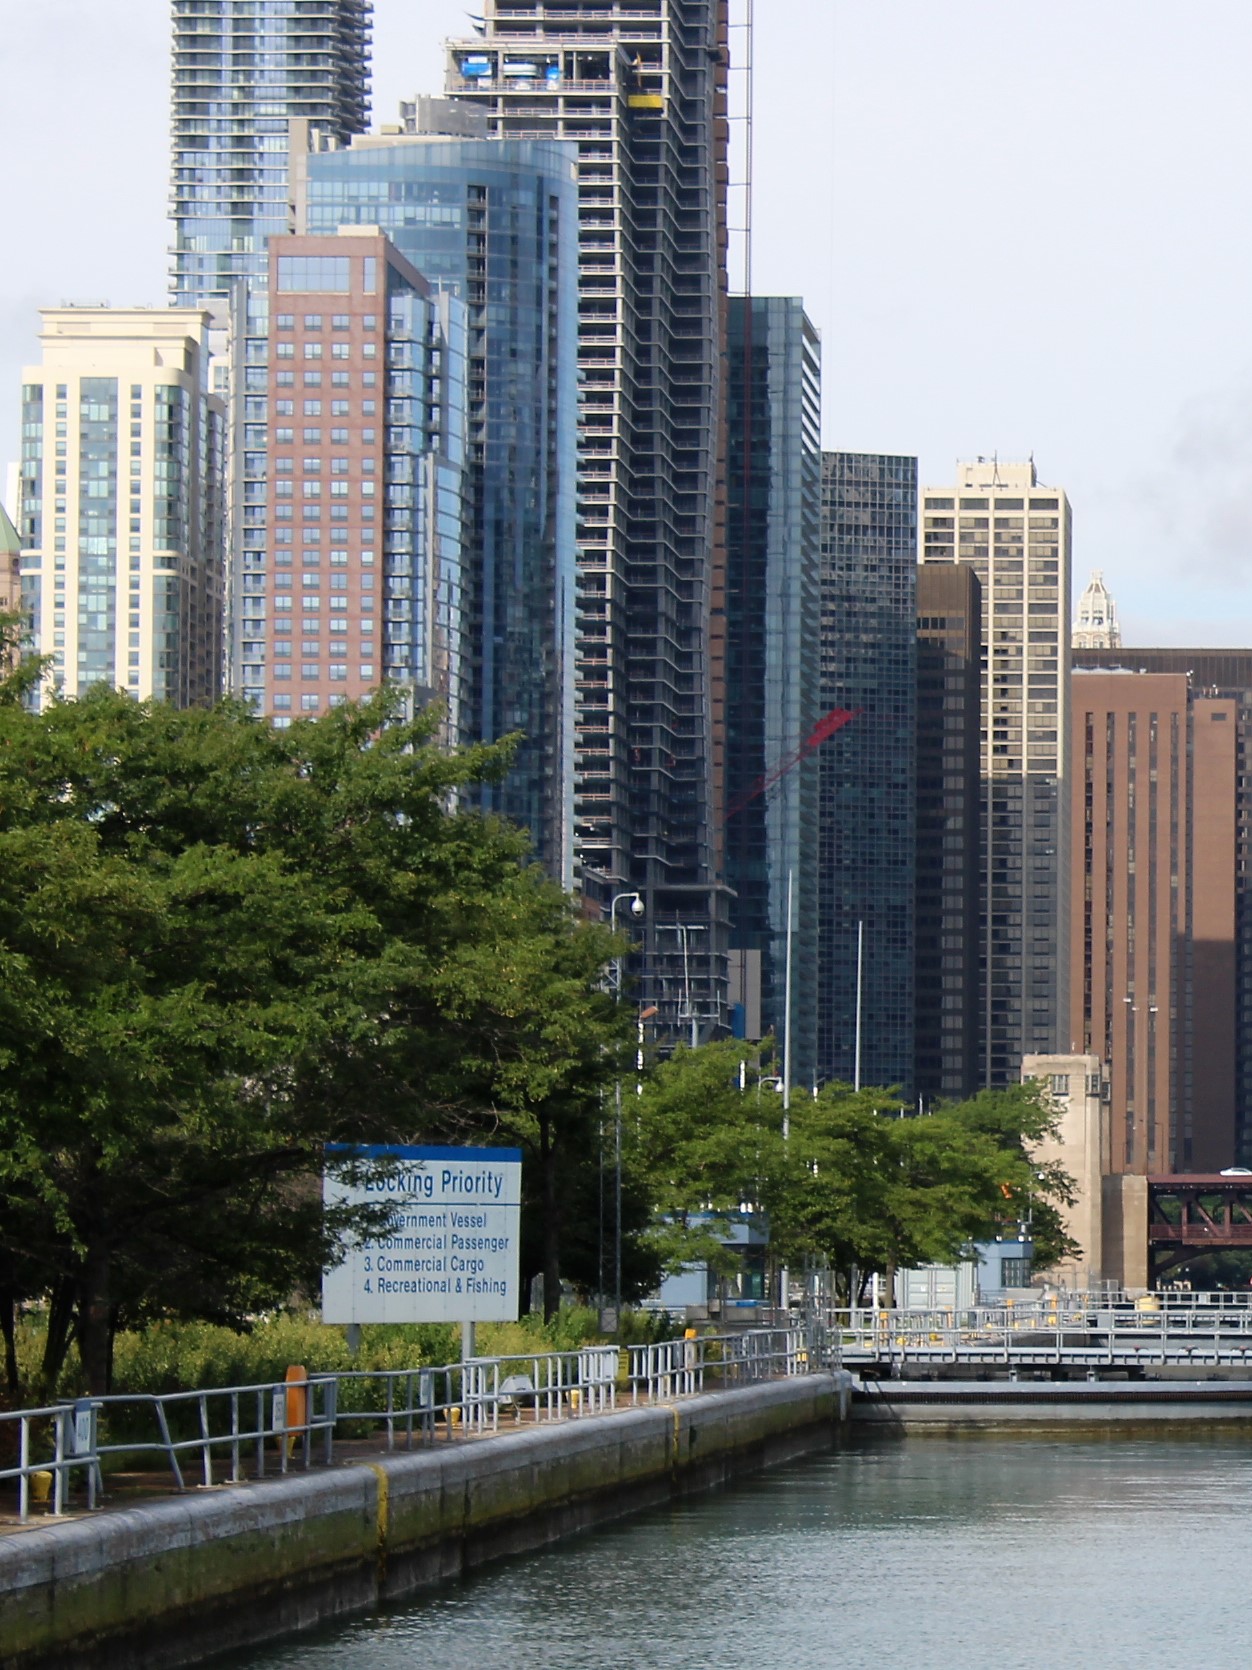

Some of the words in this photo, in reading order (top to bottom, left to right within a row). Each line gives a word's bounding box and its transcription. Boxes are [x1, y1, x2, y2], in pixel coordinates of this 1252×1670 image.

[365, 1170, 433, 1198] Locking
[442, 1169, 503, 1198] Priority
[379, 1212, 447, 1229] overnment
[450, 1212, 487, 1228] Vessel
[378, 1234, 447, 1250] Commercial
[451, 1234, 509, 1252] Passenger
[364, 1256, 374, 1272] 3.
[377, 1255, 447, 1272] Commercial
[450, 1255, 485, 1274] Cargo
[364, 1278, 373, 1294] 4.
[378, 1277, 451, 1293] Recreational
[455, 1278, 462, 1293] &
[466, 1277, 507, 1296] Fishing
